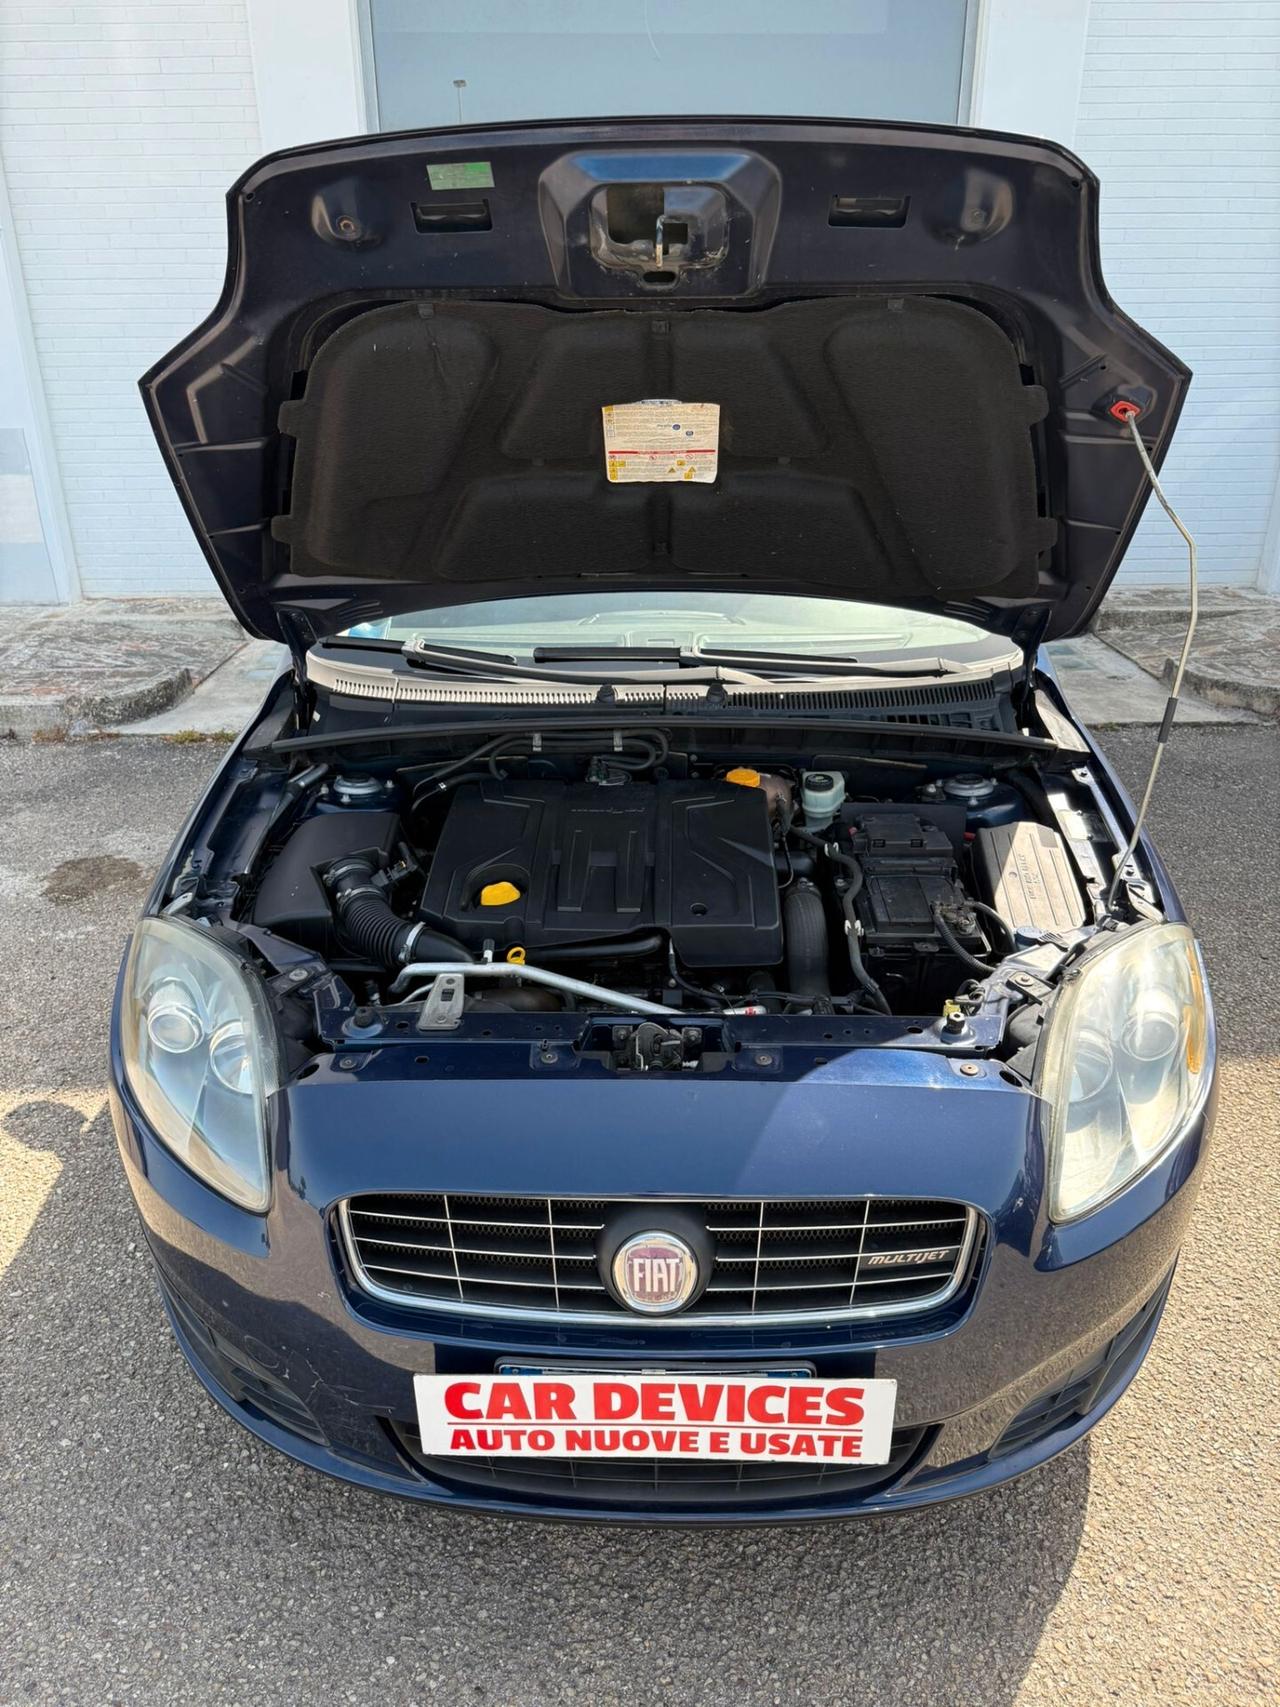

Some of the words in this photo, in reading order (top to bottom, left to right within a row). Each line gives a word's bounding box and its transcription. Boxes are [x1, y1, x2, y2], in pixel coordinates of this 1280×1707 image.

[867, 1249, 950, 1265] MULTIJET
[633, 1258, 680, 1293] FIAT
[444, 1382, 576, 1420] CAR
[593, 1382, 865, 1426] DEVICES
[450, 1429, 555, 1451] AUTO
[566, 1430, 699, 1453] NUOVE
[709, 1431, 730, 1453] E
[741, 1432, 863, 1458] USATE
